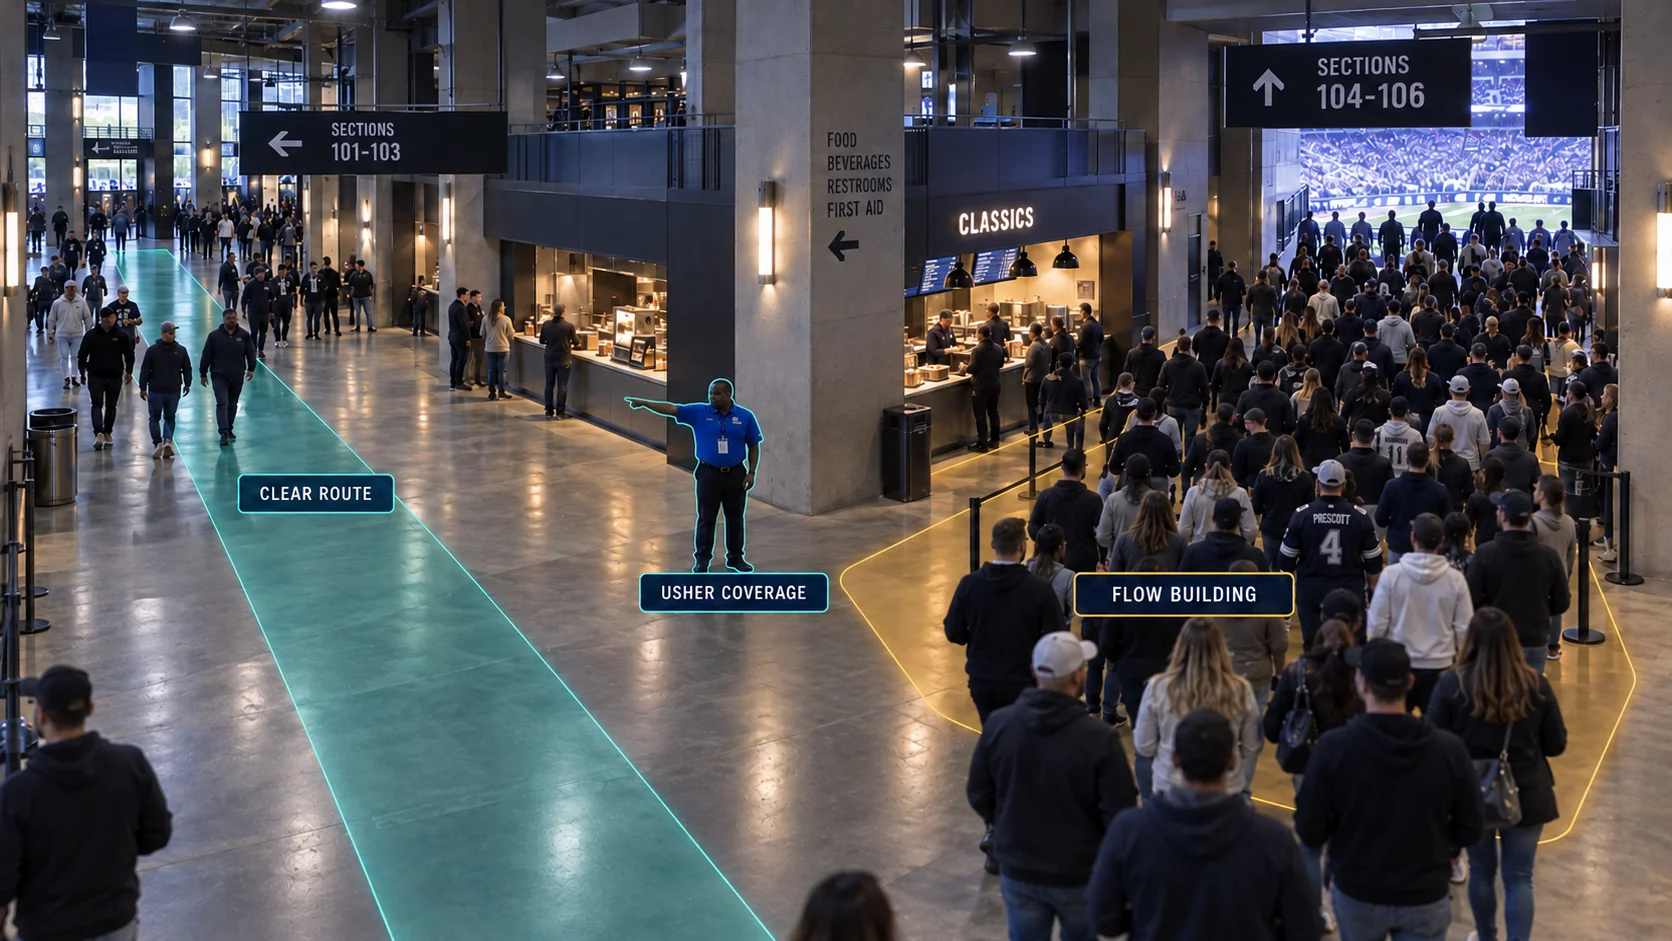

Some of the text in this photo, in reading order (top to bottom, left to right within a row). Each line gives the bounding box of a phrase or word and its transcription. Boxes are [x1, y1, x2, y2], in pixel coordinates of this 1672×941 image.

[1317, 55, 1410, 76] SECTIONS
[1316, 82, 1425, 110] 104-106
[331, 122, 395, 136] SECTIONS
[827, 132, 857, 148] FOOD
[331, 142, 401, 161] 101-103
[827, 154, 891, 171] BEVERAGES
[827, 177, 892, 194] RESTROOMS
[827, 199, 884, 218] FIRST AID
[958, 206, 1034, 235] CLASSICS
[1312, 513, 1351, 525] PRESCOTT
[1319, 528, 1342, 565] 4
